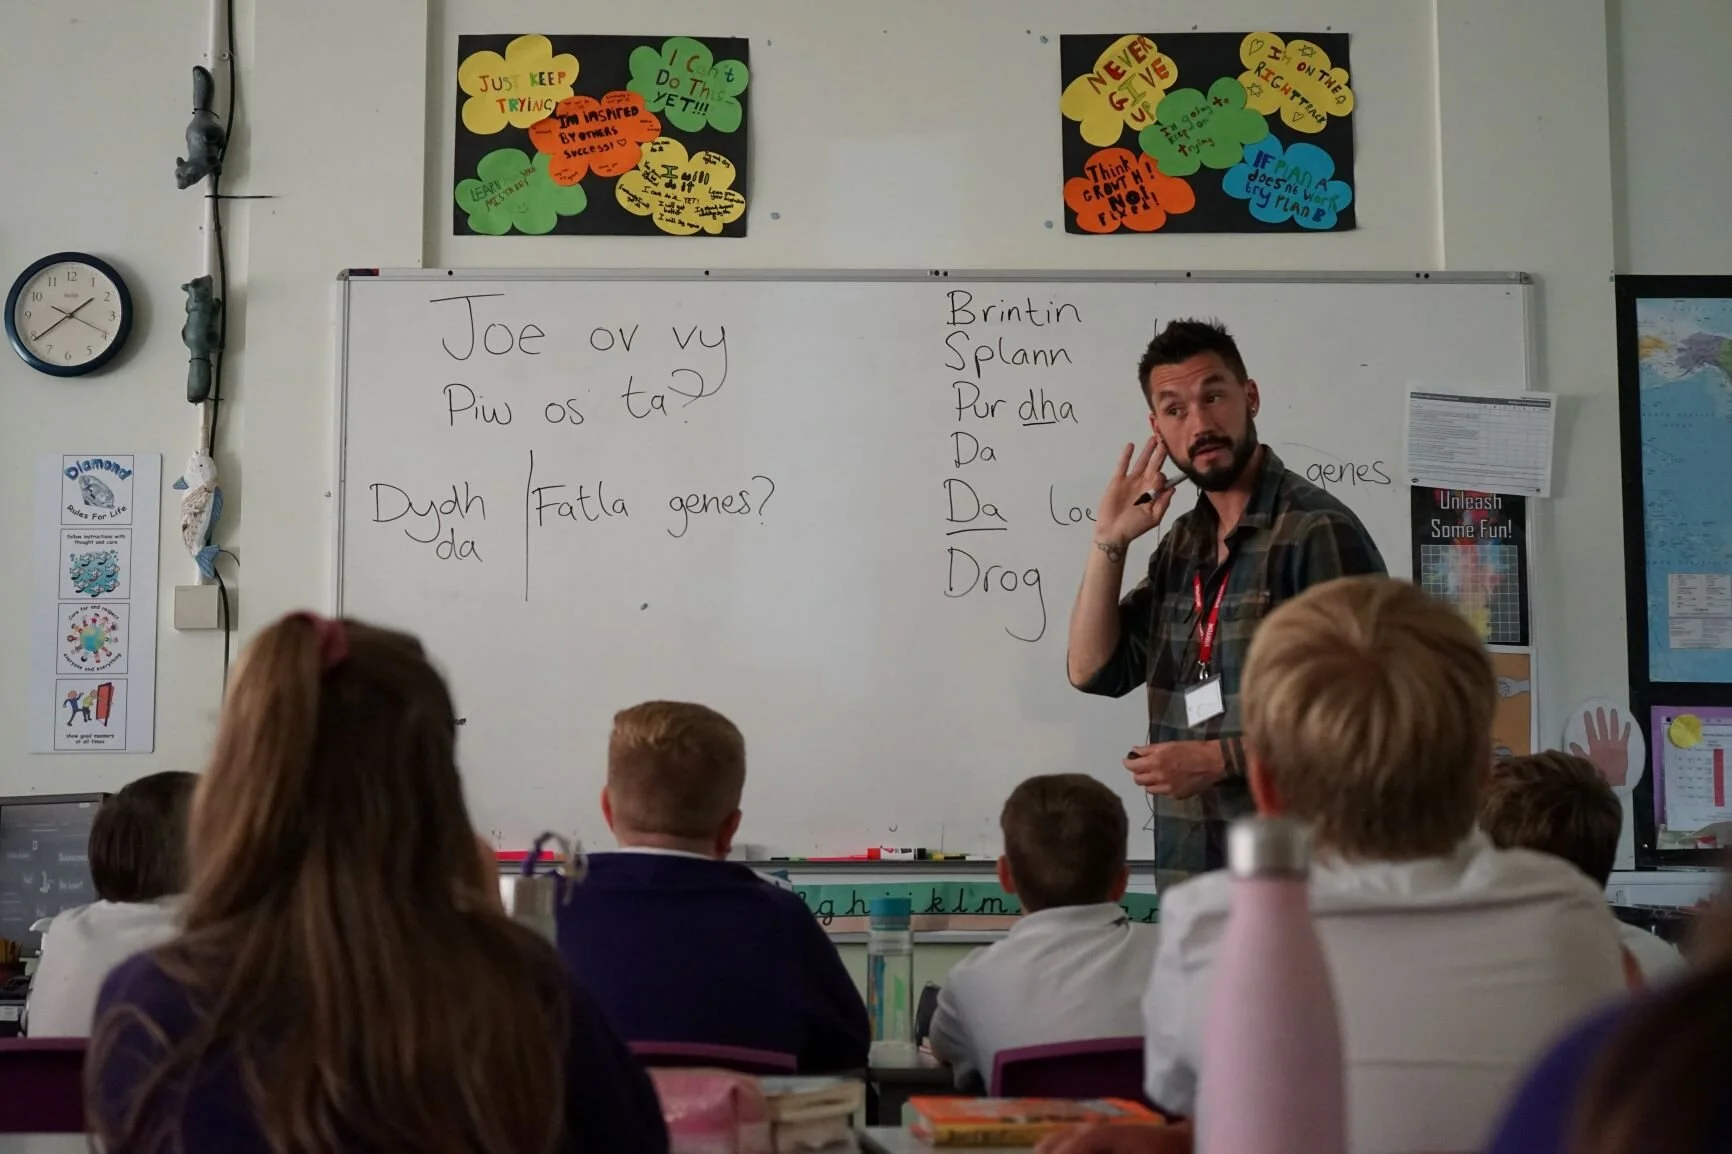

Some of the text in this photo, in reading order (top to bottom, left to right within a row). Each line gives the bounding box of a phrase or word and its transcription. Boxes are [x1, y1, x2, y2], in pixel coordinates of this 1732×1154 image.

[668, 48, 678, 66] I
[1086, 35, 1153, 95] NEVER
[478, 71, 567, 93] JUST KEEP
[1108, 57, 1169, 111] GIVE
[1254, 61, 1302, 101] RIGHT
[1296, 61, 1316, 77] ON
[1317, 69, 1343, 95] THE
[652, 91, 710, 116] YET!!!
[1086, 155, 1132, 183] Think
[1315, 178, 1327, 192] A
[48, 277, 57, 287] 11
[67, 271, 77, 281] 12
[32, 292, 43, 302] 10
[104, 292, 111, 301] 2
[946, 289, 1082, 326] Brintin
[25, 311, 32, 319] 9
[109, 311, 116, 321] 3
[30, 331, 37, 340] 8
[430, 294, 728, 398] Joe ov vy
[46, 345, 52, 354] 7
[64, 351, 72, 360] 6
[87, 346, 93, 355] 5
[945, 330, 1072, 379] Splann
[443, 368, 705, 427] Piw os ta?
[952, 381, 1079, 425] Pur dha
[951, 431, 996, 468] Da
[64, 458, 132, 481] Diamond
[1306, 460, 1391, 489] genes
[67, 504, 89, 519] Rules
[110, 505, 128, 518] Life
[370, 481, 486, 543] Dydh
[532, 475, 775, 538] Fatla genes?
[944, 478, 1008, 523] Da
[1440, 490, 1502, 510] Unleash
[1431, 518, 1512, 539] Some Fun!
[436, 528, 484, 563] da
[943, 547, 1047, 642] Drog
